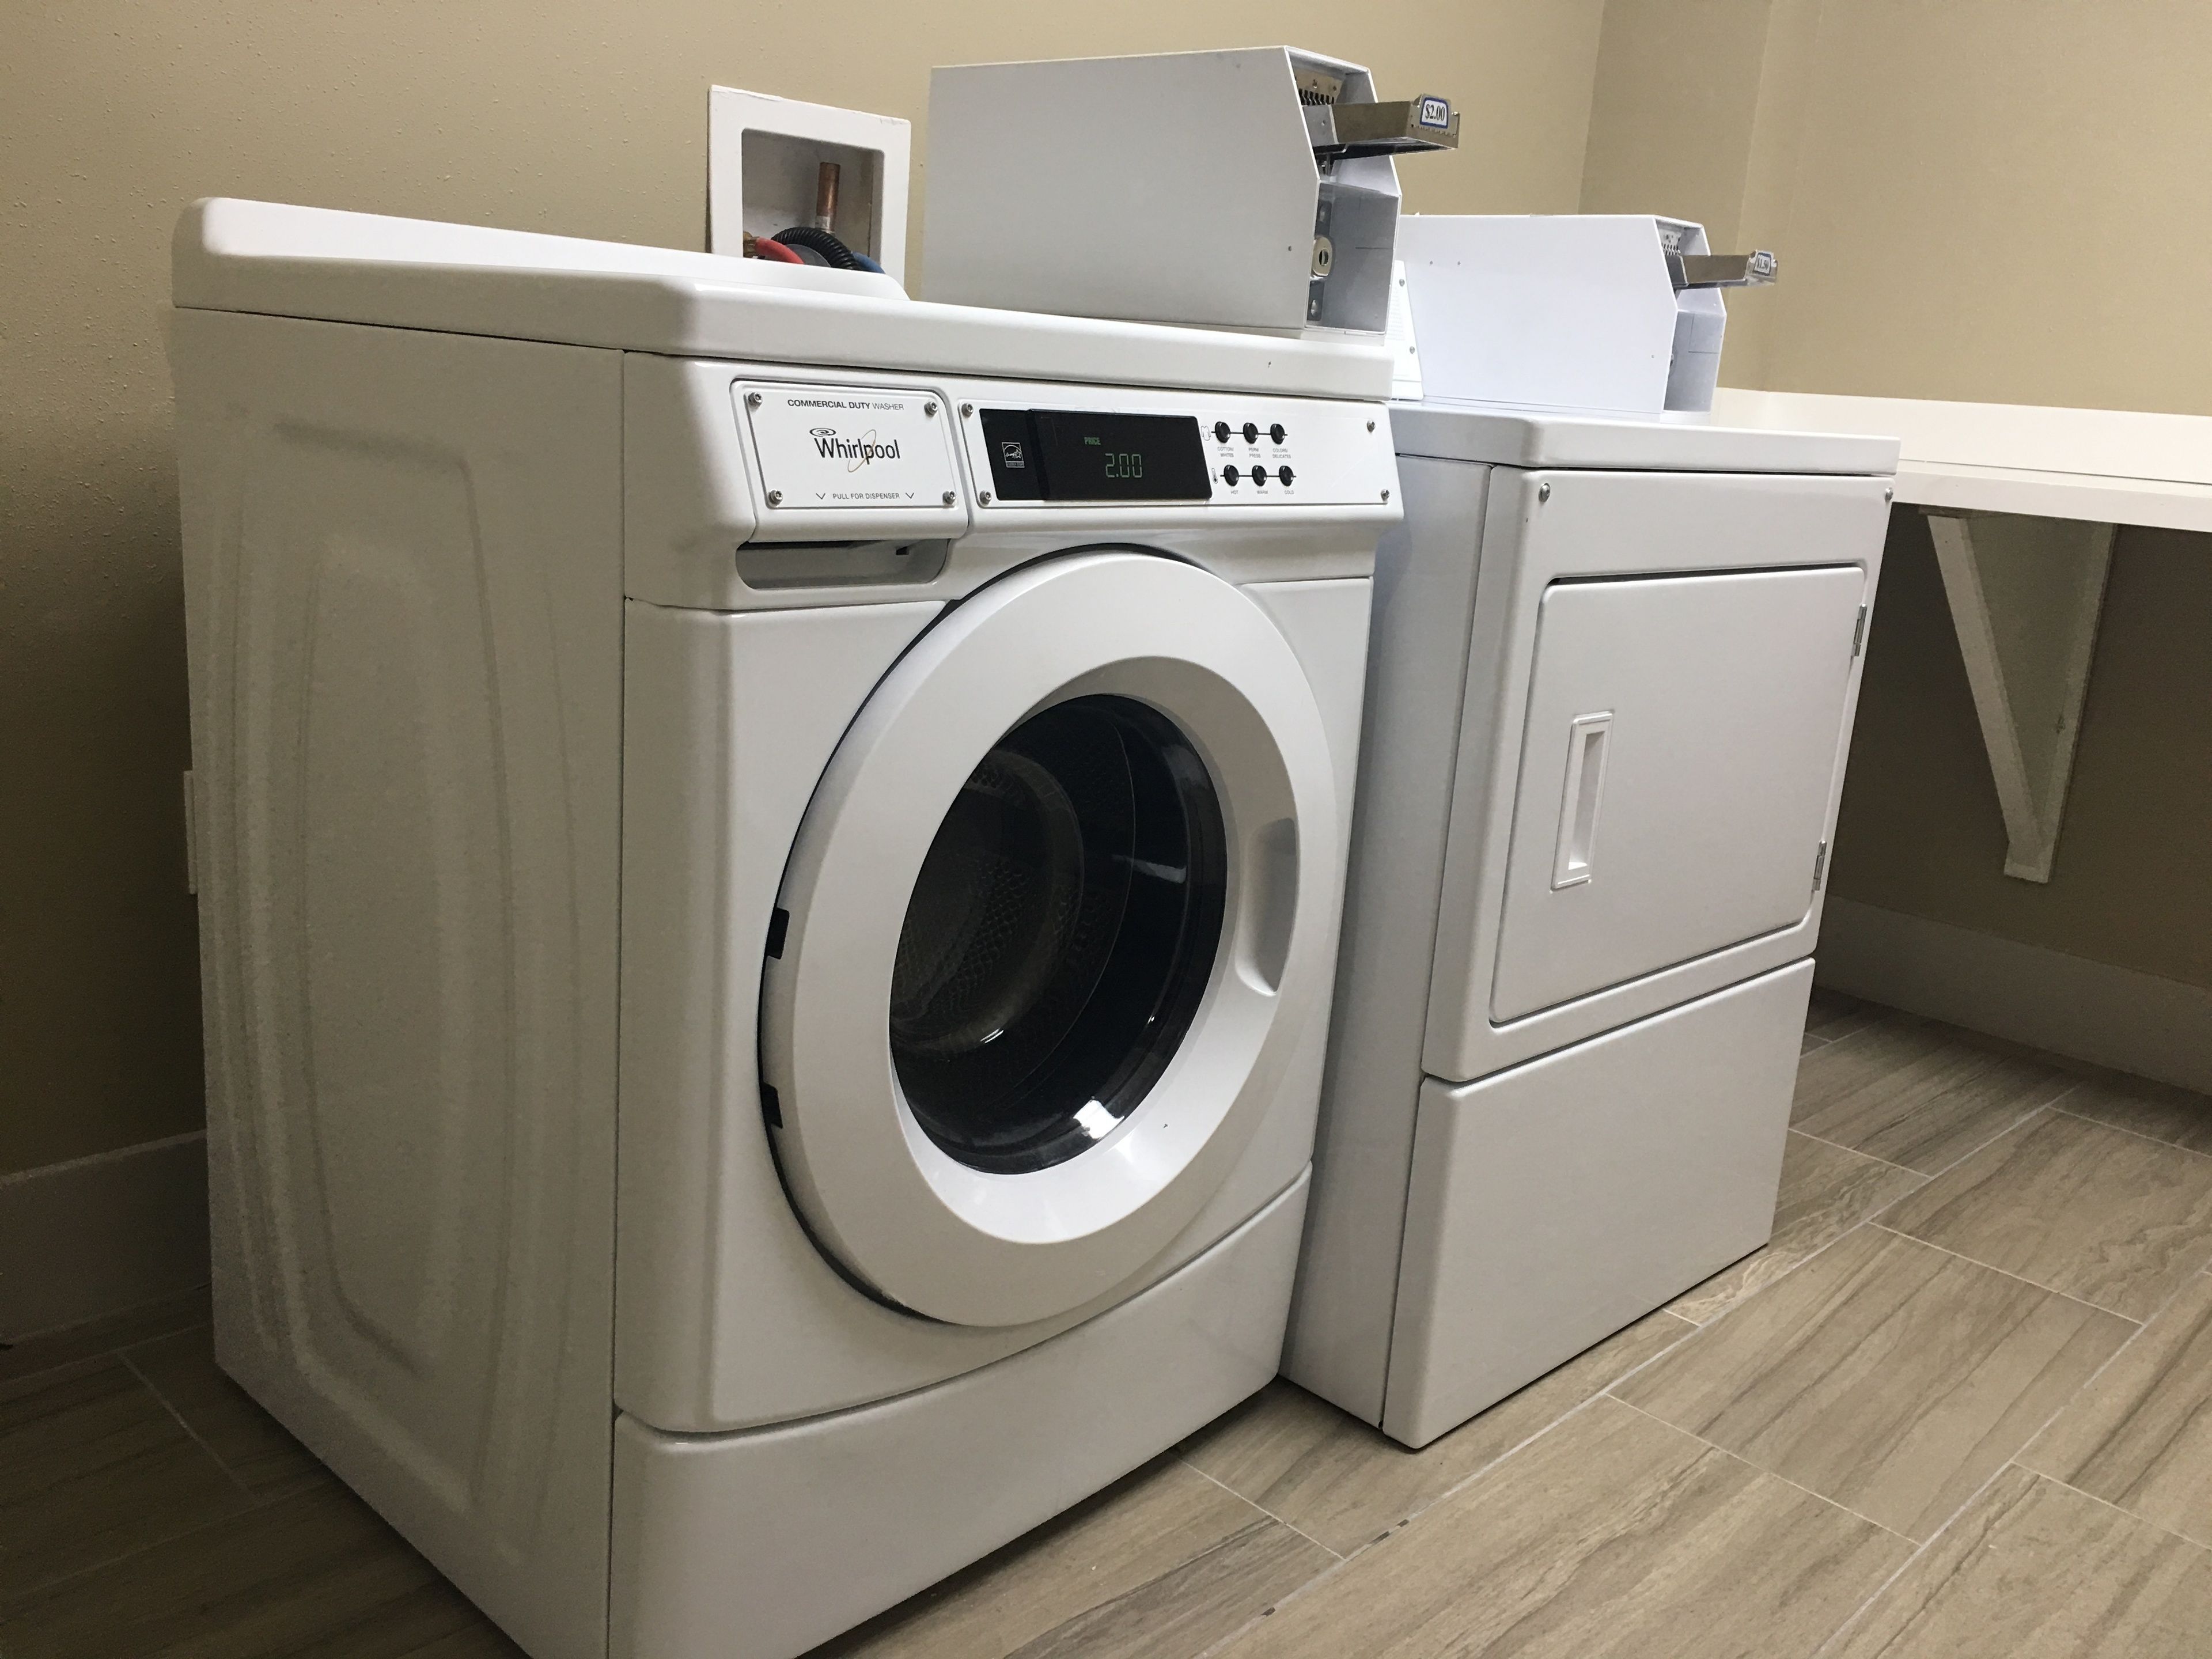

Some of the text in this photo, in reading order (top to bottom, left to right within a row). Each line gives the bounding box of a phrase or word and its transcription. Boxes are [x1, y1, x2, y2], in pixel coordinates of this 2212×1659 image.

[1425, 104, 1445, 122] $2.00
[787, 399, 847, 408] COMMERCIAL
[814, 438, 900, 465] Whirlpool
[1105, 453, 1142, 478] 2.00
